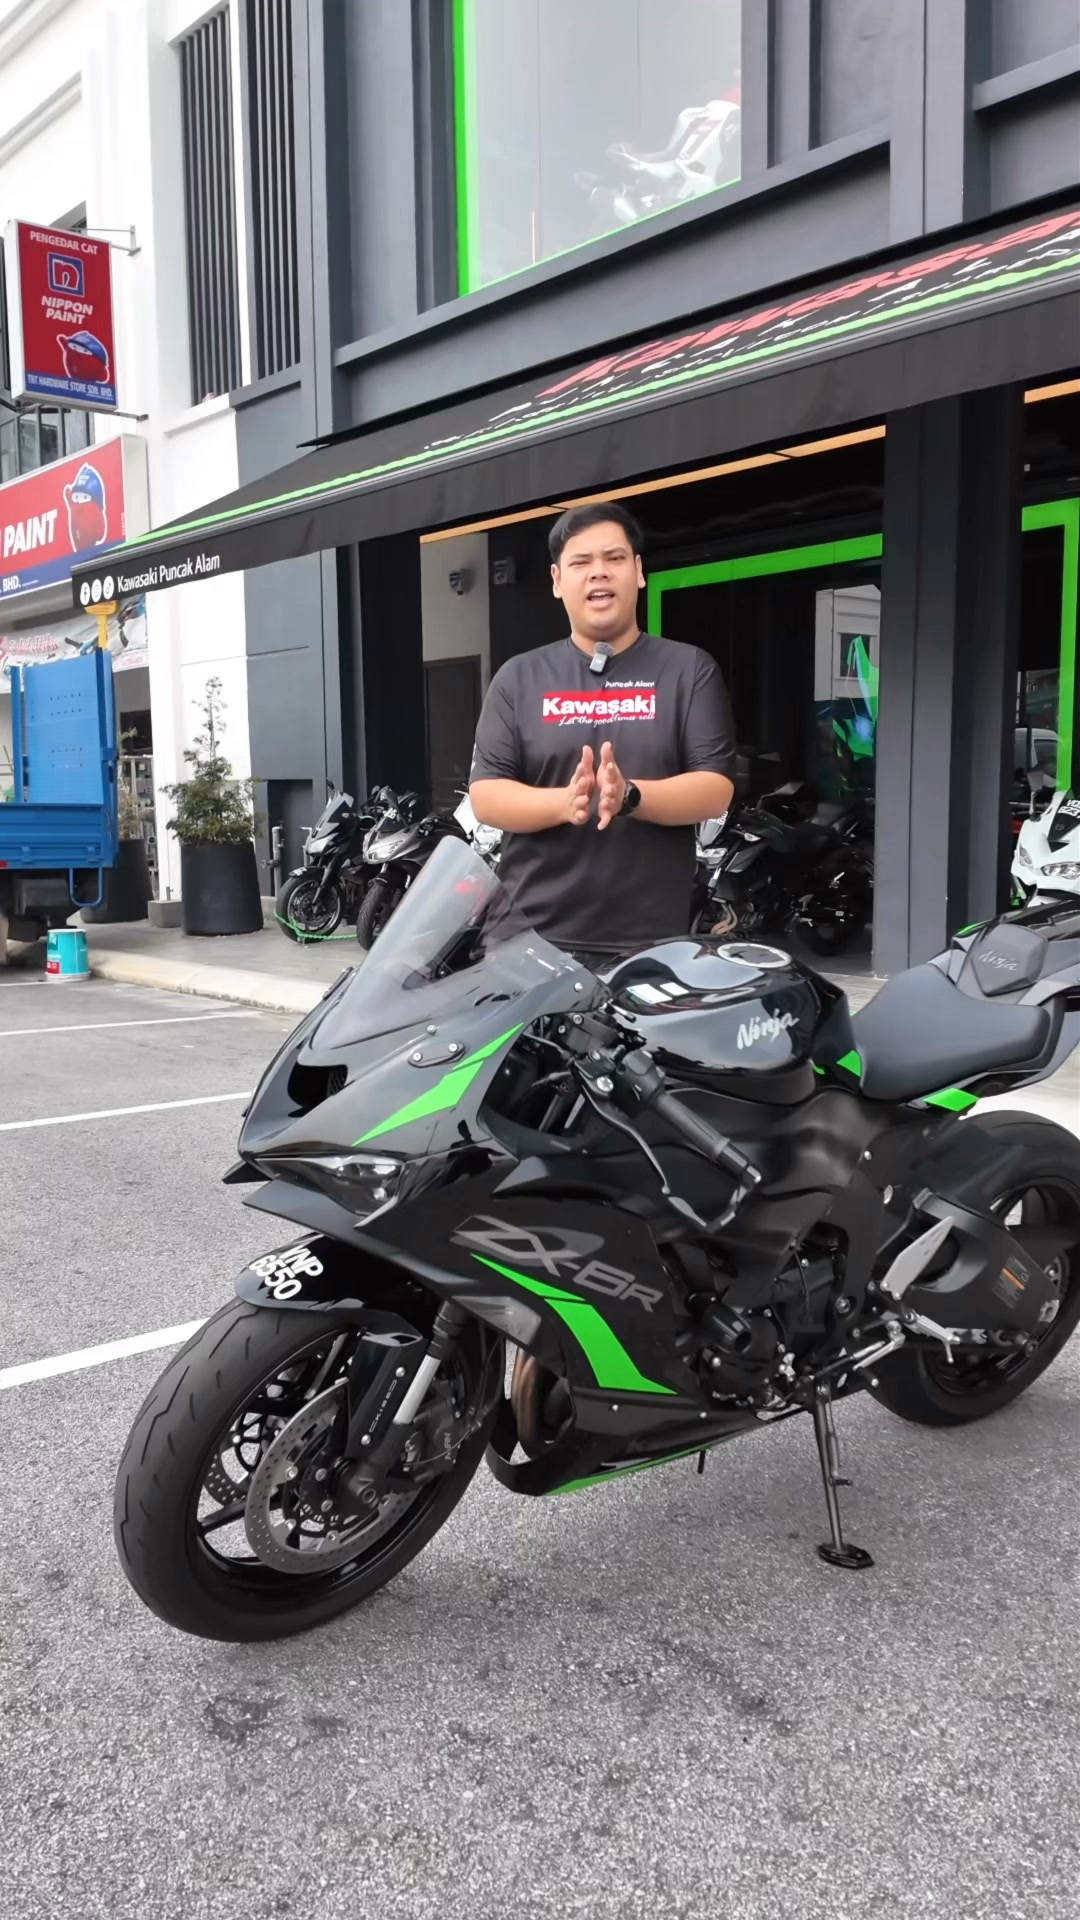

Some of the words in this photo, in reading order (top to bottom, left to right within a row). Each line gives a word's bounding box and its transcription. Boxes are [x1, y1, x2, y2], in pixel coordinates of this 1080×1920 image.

[30, 231, 80, 251] PENGEDAR
[81, 243, 98, 255] CAT
[41, 295, 93, 316] NIPPON
[46, 308, 86, 325] PAINT
[535, 211, 1080, 398] Kawasa
[69, 381, 86, 393] STORE
[3, 508, 58, 558] PAINT
[2, 575, 21, 592] BHD.
[117, 567, 157, 593] Kawasaki
[159, 557, 193, 583] Puncak
[194, 553, 220, 575] Alam
[543, 694, 656, 716] Kawasaki
[979, 950, 1018, 971] Ninja
[737, 1008, 800, 1050] Ninja
[450, 1214, 664, 1313] ZX-6R
[248, 1254, 302, 1300] 6550
